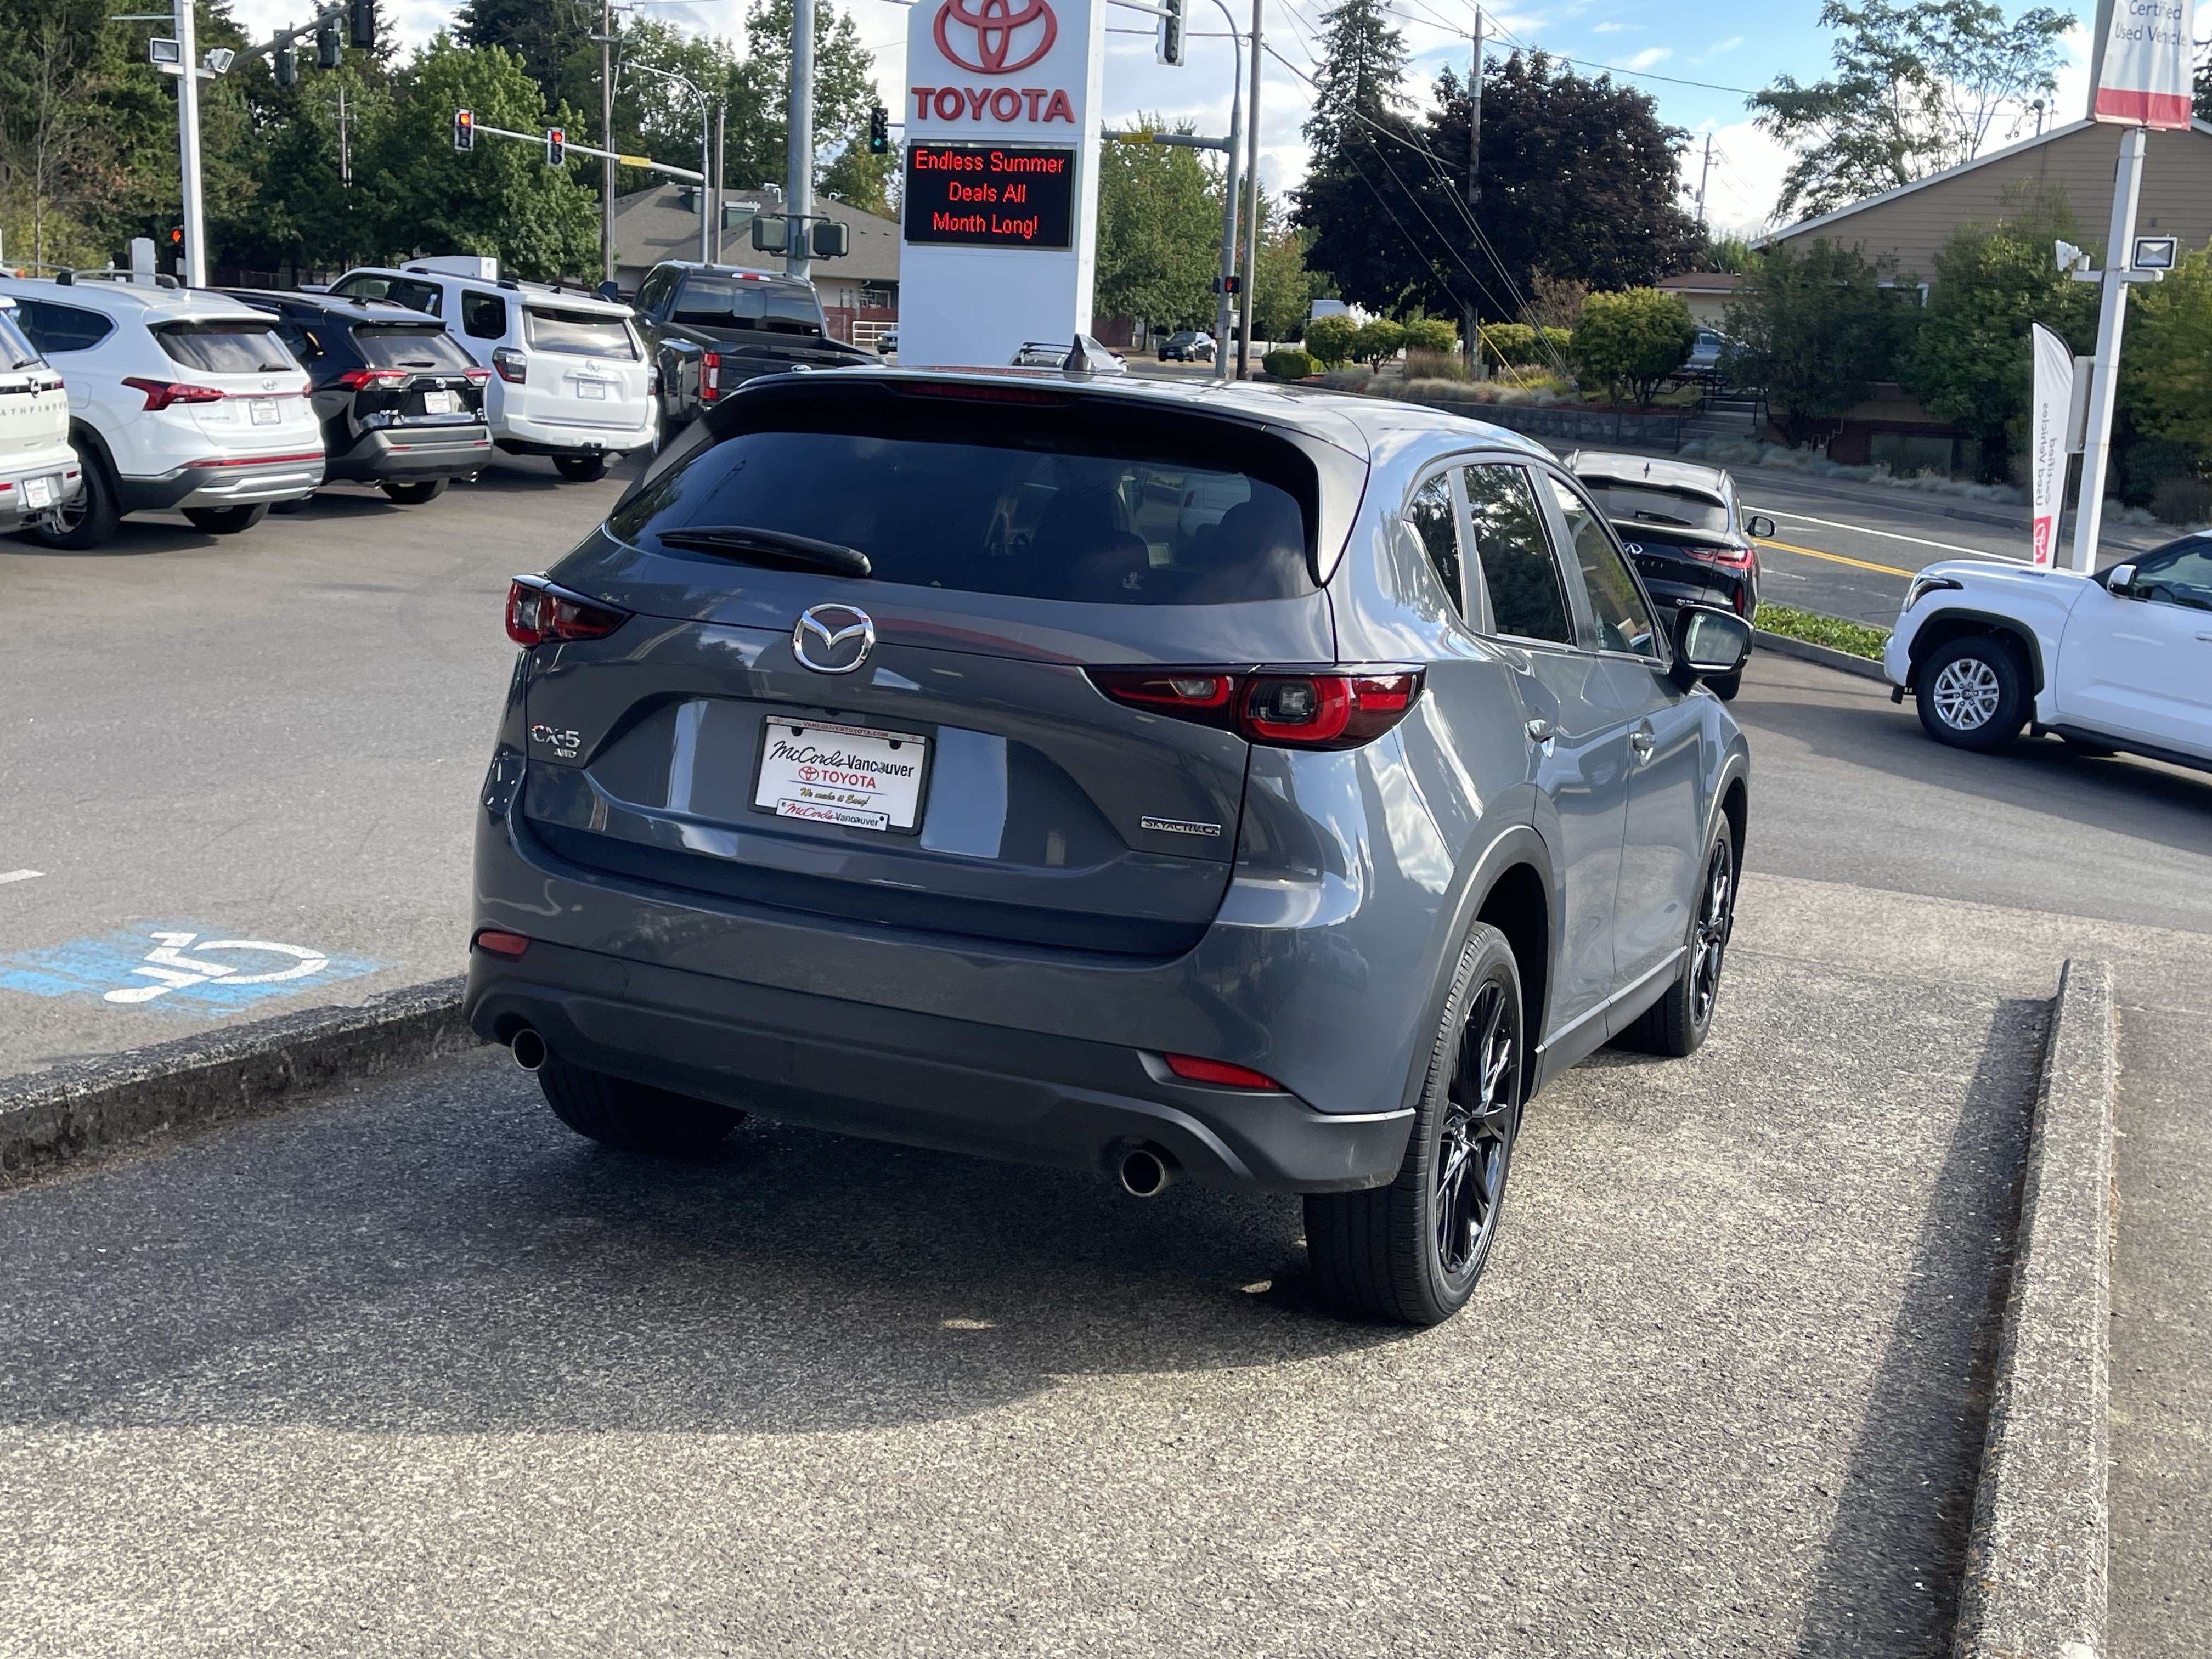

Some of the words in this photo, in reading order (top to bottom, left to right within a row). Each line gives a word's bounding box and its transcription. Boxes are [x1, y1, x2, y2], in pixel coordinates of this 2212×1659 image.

[2115, 22, 2143, 40] Used
[911, 87, 1075, 123] TOYOTA
[915, 150, 984, 171] Endless
[990, 151, 1065, 173] Summer
[948, 182, 997, 202] Deals
[1002, 184, 1026, 203] All
[933, 212, 986, 233] Month
[991, 214, 1039, 240] Long!
[531, 724, 581, 748] CX-5
[821, 770, 877, 789] TOYOTA
